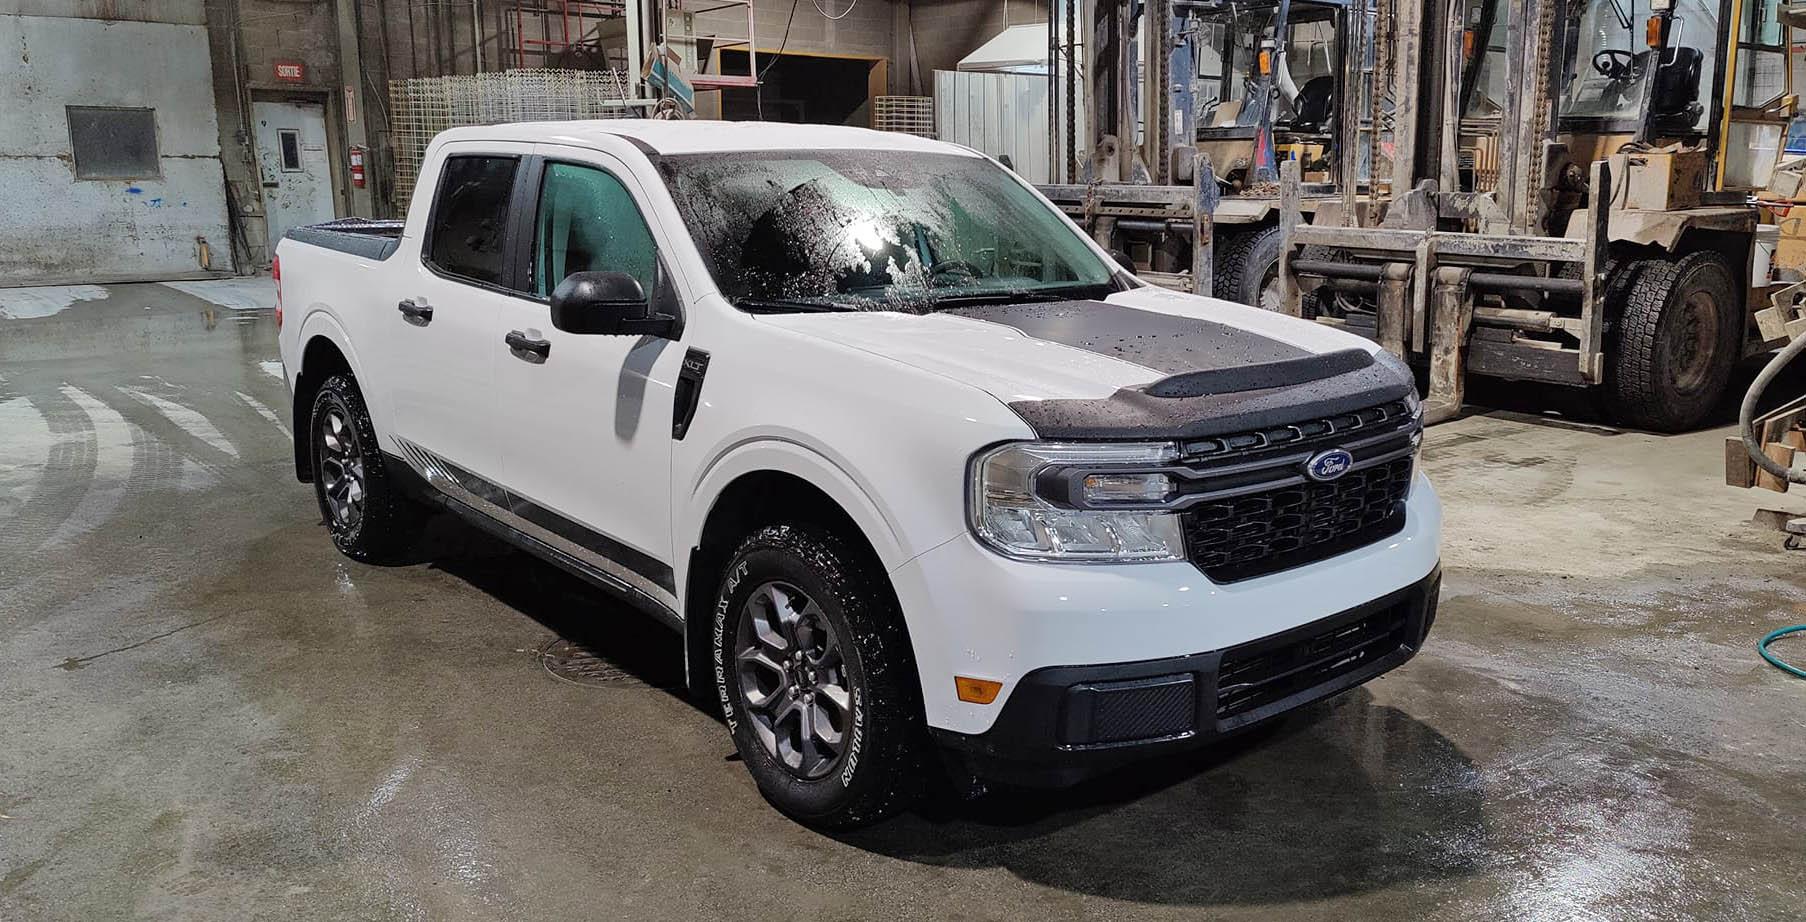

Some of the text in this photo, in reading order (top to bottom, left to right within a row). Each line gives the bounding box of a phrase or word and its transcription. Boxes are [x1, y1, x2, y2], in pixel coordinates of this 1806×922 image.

[277, 65, 301, 77] SORTIE
[684, 359, 704, 370] XLT
[1321, 456, 1345, 475] Ford
[713, 560, 748, 735] TERRAMAX A/T
[841, 686, 863, 788] SAILUN
